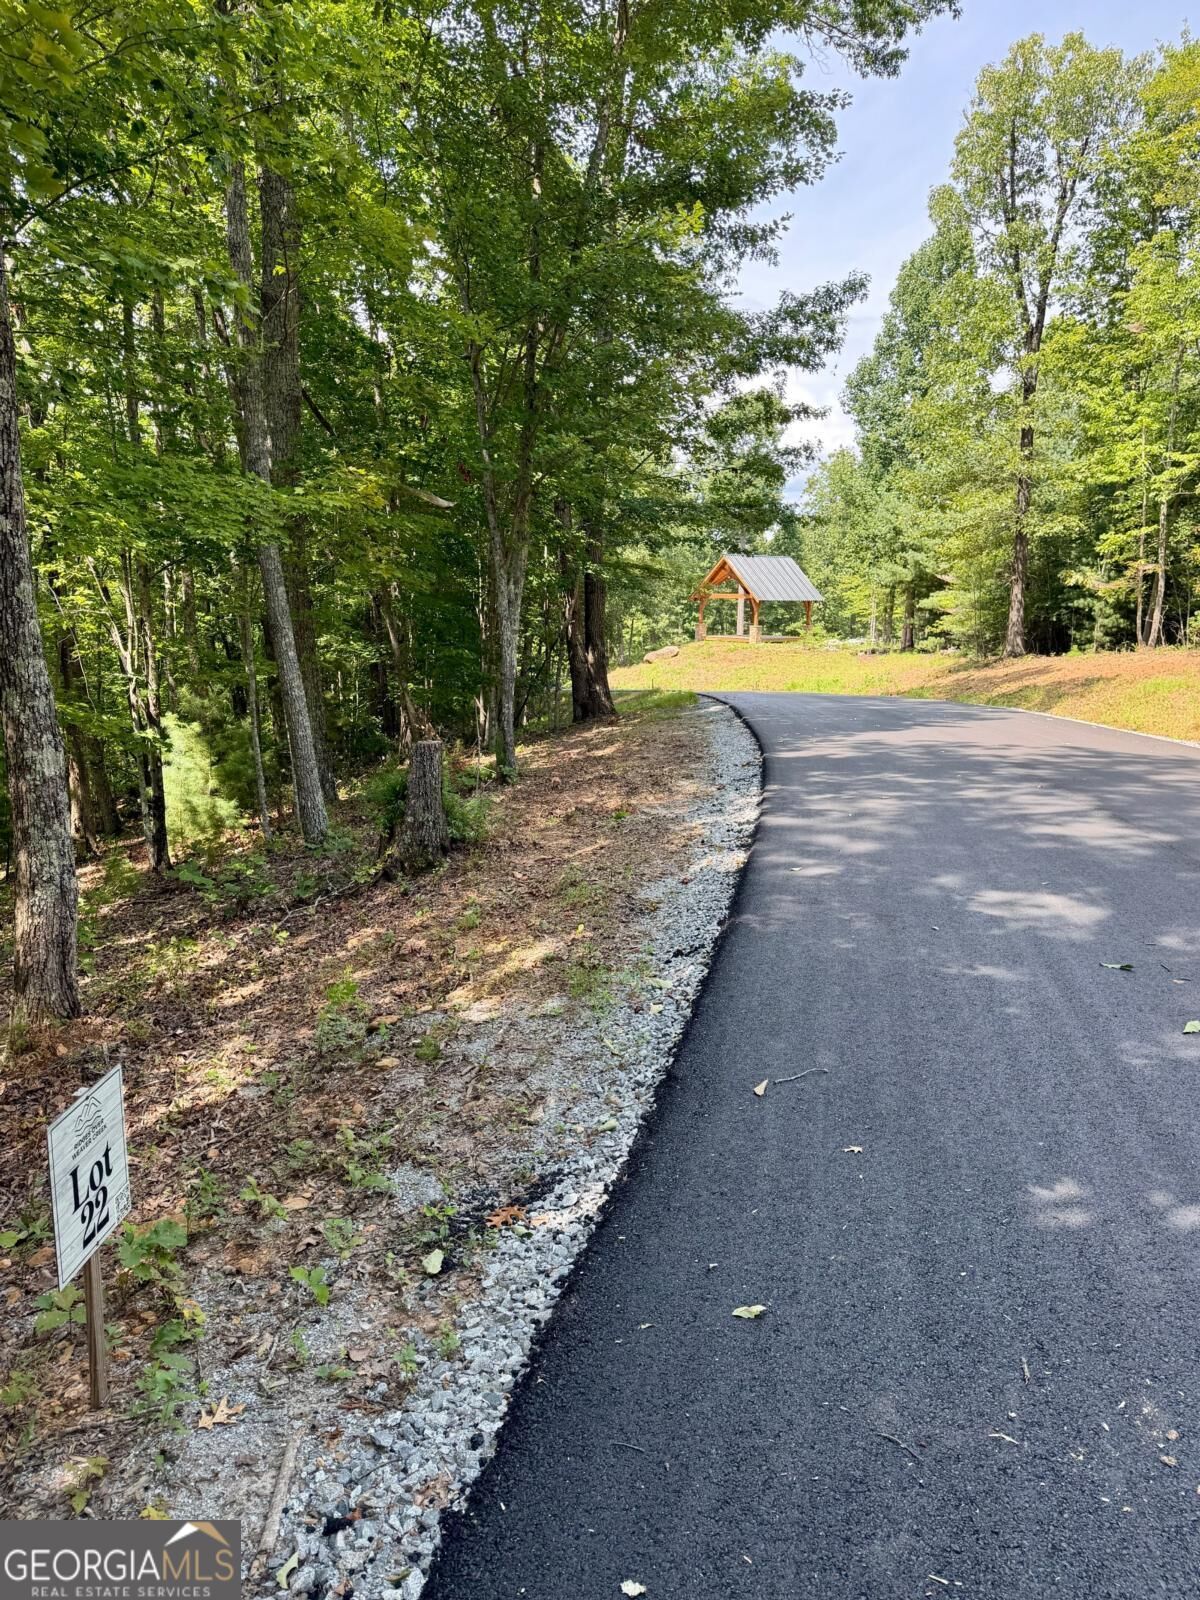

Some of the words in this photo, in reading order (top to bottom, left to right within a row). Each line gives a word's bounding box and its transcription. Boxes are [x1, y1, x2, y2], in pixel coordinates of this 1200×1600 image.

[72, 1138, 92, 1160] WEAVER
[92, 1124, 107, 1140] CREEK
[74, 1131, 91, 1149] RIDGES
[92, 1118, 104, 1133] OVER
[70, 1139, 113, 1215] Lot
[81, 1186, 110, 1249] 22
